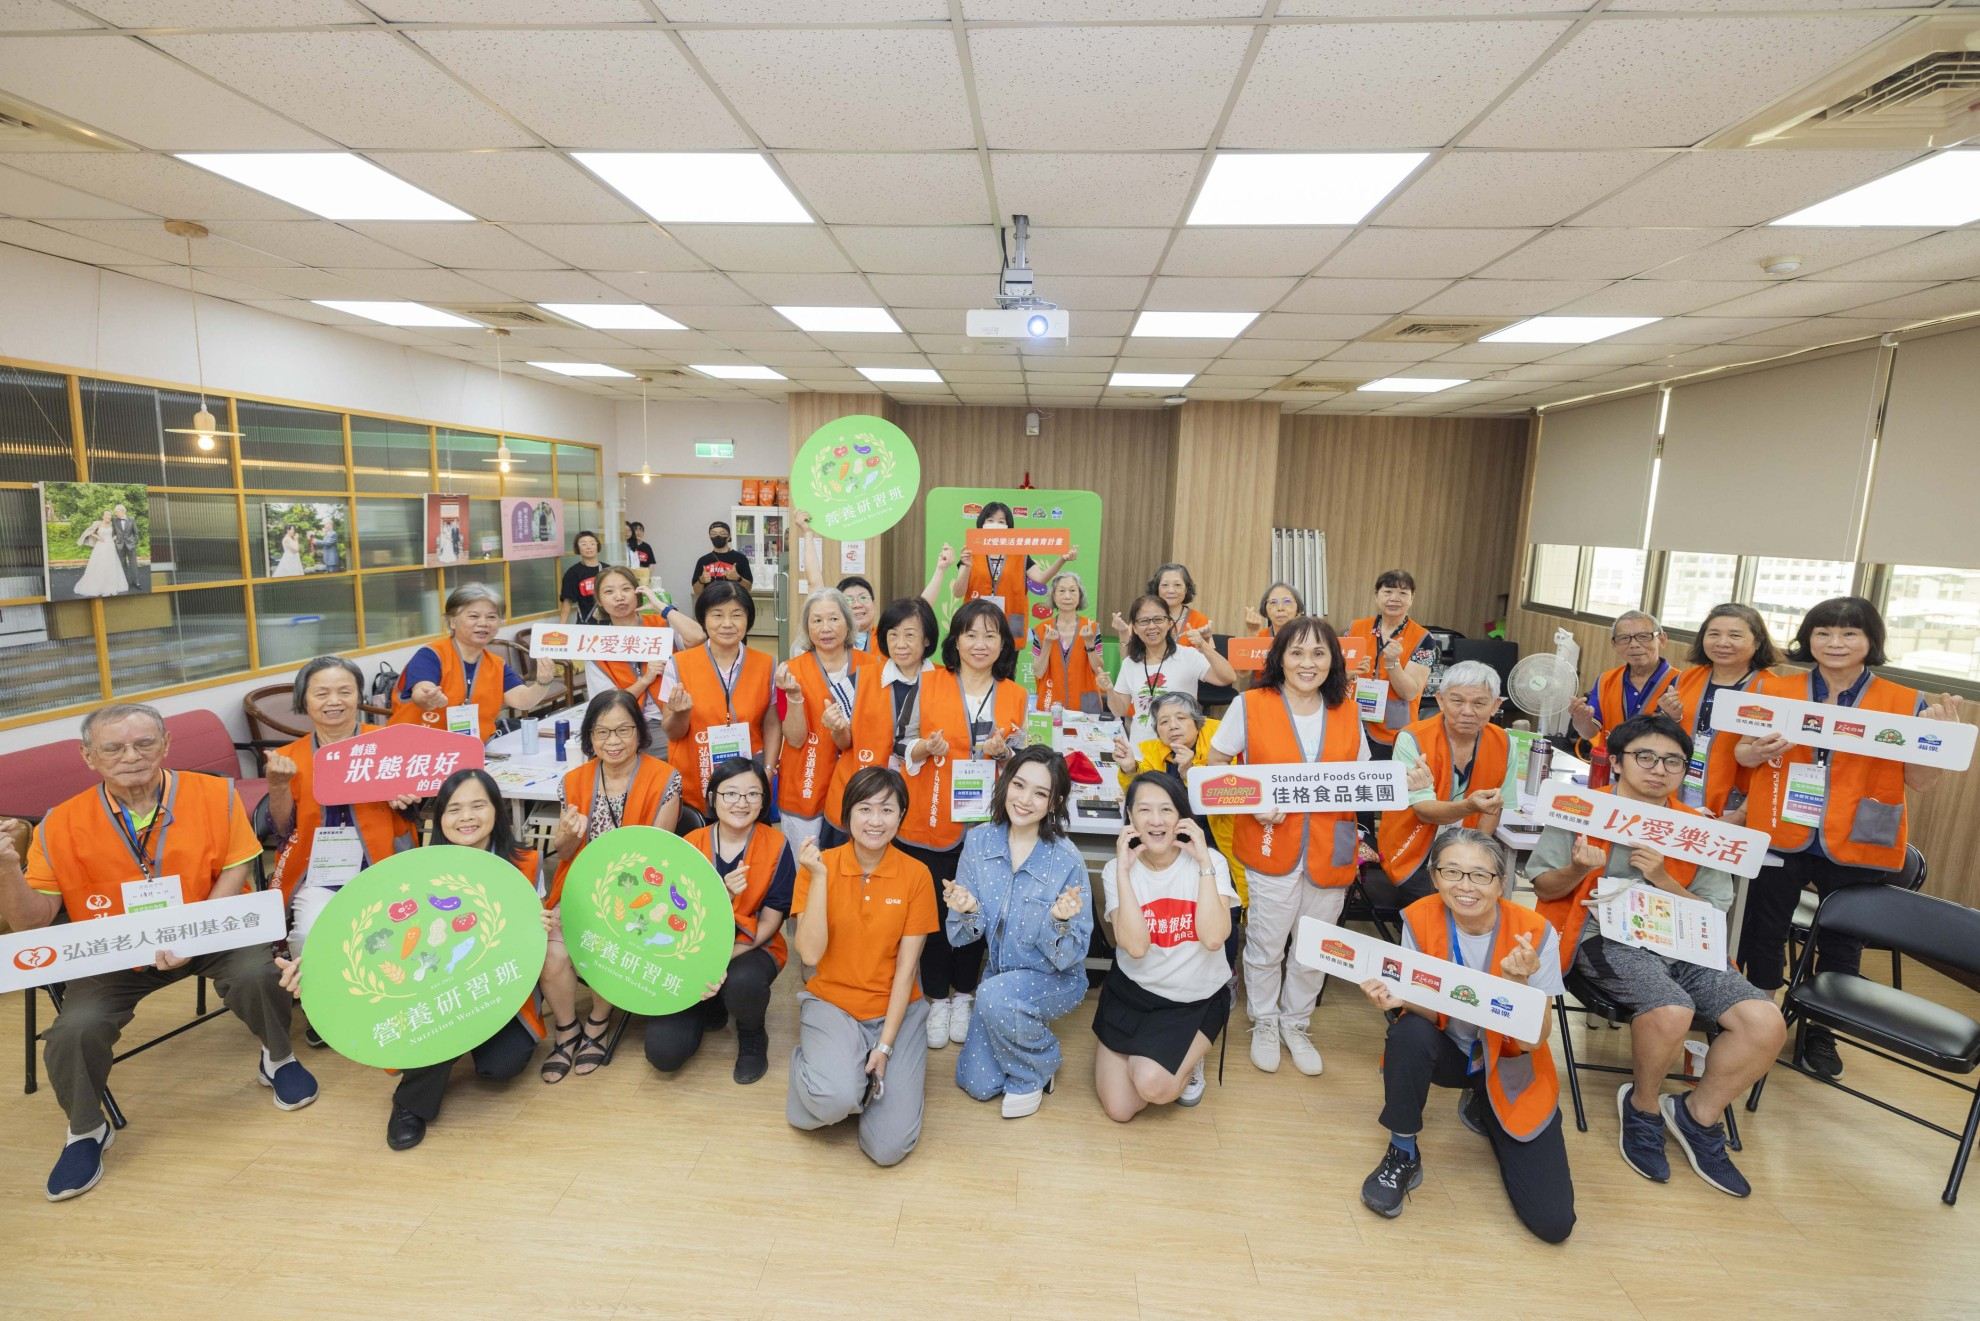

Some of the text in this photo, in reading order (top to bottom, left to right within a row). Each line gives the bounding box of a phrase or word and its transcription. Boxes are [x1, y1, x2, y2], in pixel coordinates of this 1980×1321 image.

[577, 634, 663, 656] 以愛樂活
[350, 743, 378, 756] 創造
[344, 752, 461, 784] 狀態很好
[803, 746, 817, 799] 弘道基金會
[1271, 771, 1393, 783] Standard Foods Group
[416, 777, 448, 792] 的自
[1206, 787, 1256, 797] STANDARD
[1272, 784, 1395, 804] 佳格食品集團
[1217, 796, 1246, 805] FOODS
[1603, 809, 1748, 865] 以愛樂活
[62, 911, 261, 962] 弘道老人福利基金會
[580, 929, 684, 997] 營養研習班
[372, 959, 522, 1047] 營養研習班
[410, 996, 503, 1045] Nutrition Workshop
